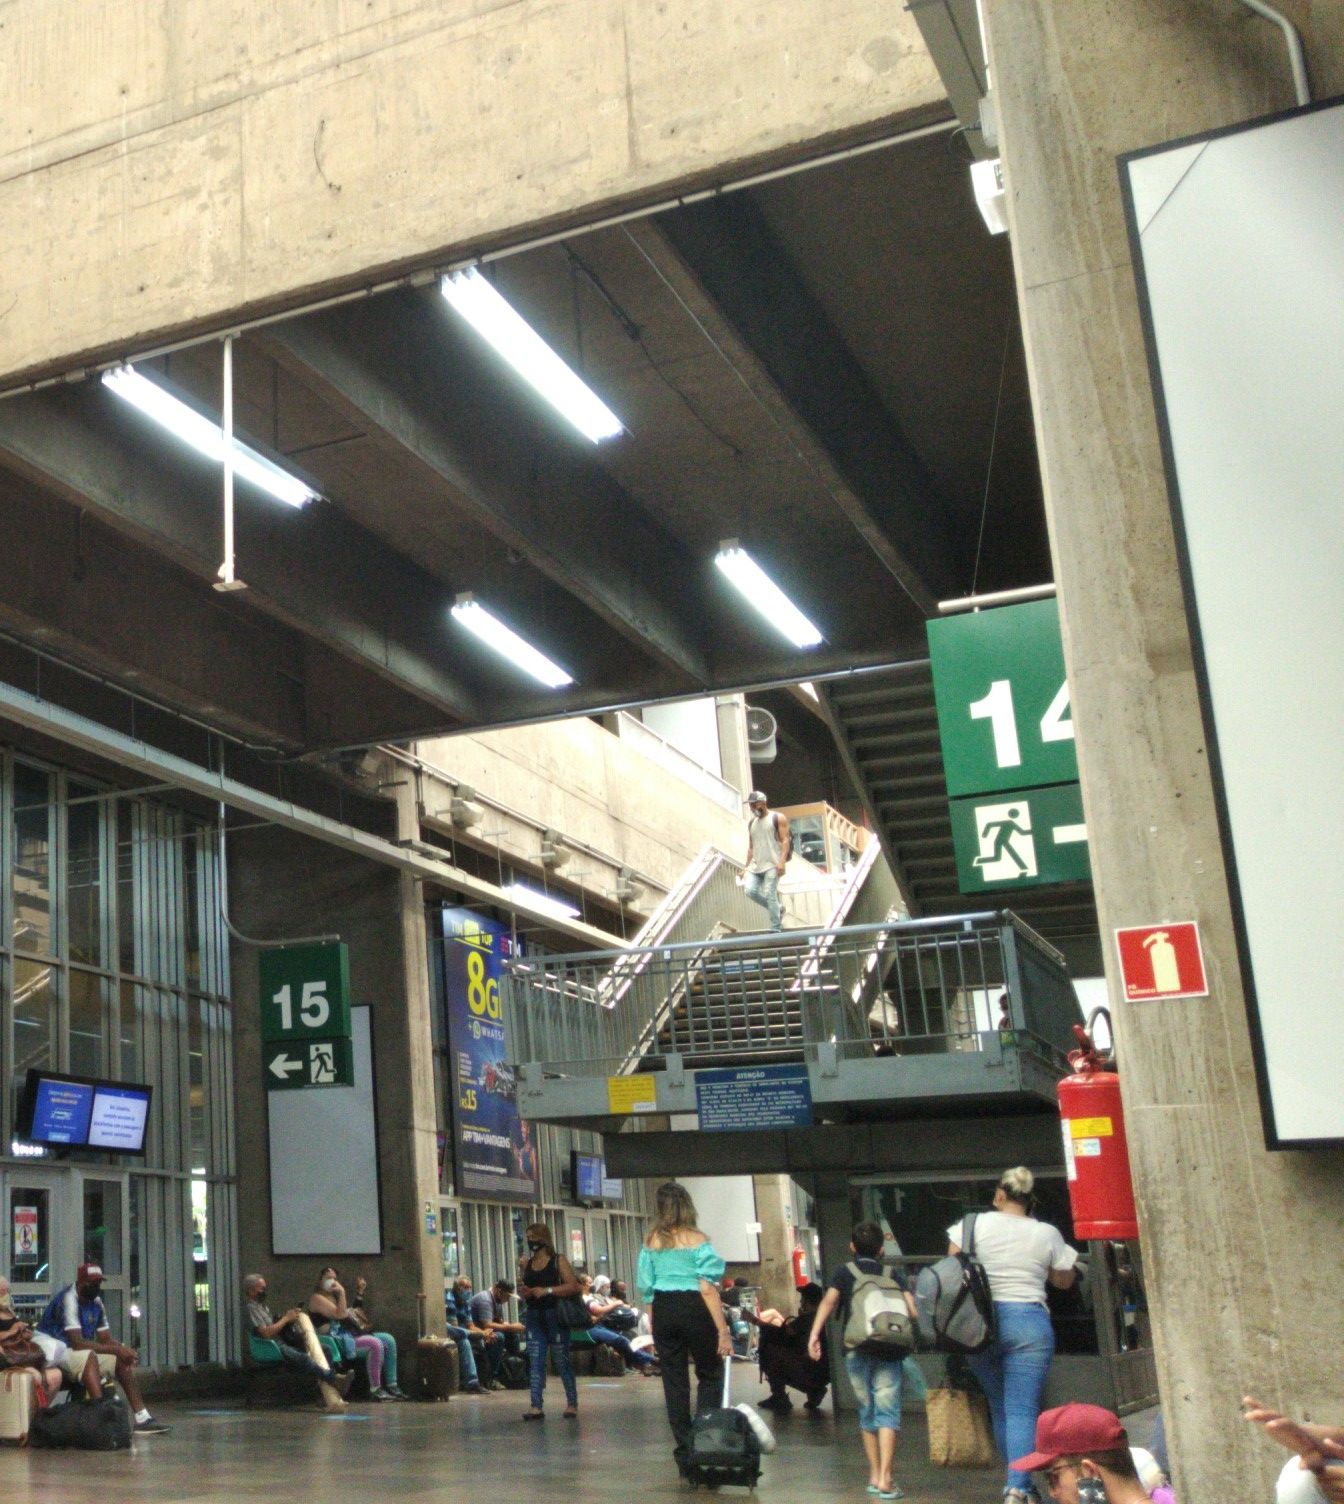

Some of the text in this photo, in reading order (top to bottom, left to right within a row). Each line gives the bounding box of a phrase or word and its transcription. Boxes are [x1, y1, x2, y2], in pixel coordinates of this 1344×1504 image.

[507, 939, 521, 958] TM
[272, 981, 330, 1030] 15
[467, 951, 503, 1020] 8G
